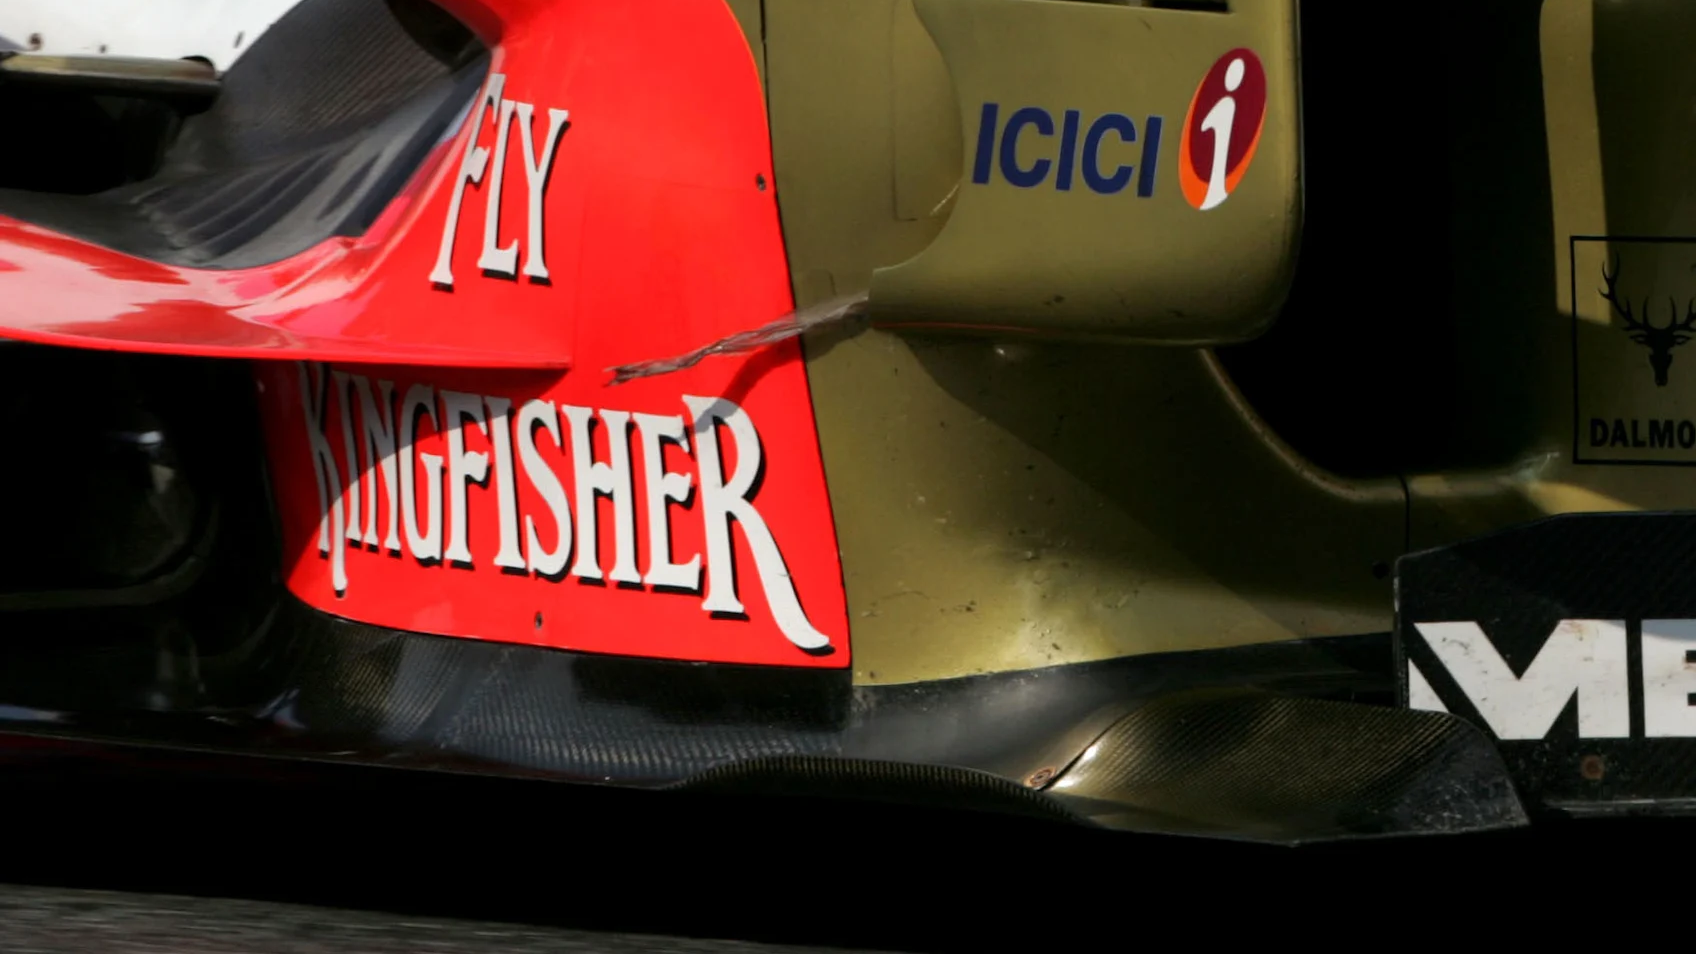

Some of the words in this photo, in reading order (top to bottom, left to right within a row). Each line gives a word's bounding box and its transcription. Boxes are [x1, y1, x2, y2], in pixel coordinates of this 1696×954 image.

[428, 73, 572, 293] FLY
[972, 104, 1163, 197] ICICI
[302, 361, 835, 655] KINGFISHER
